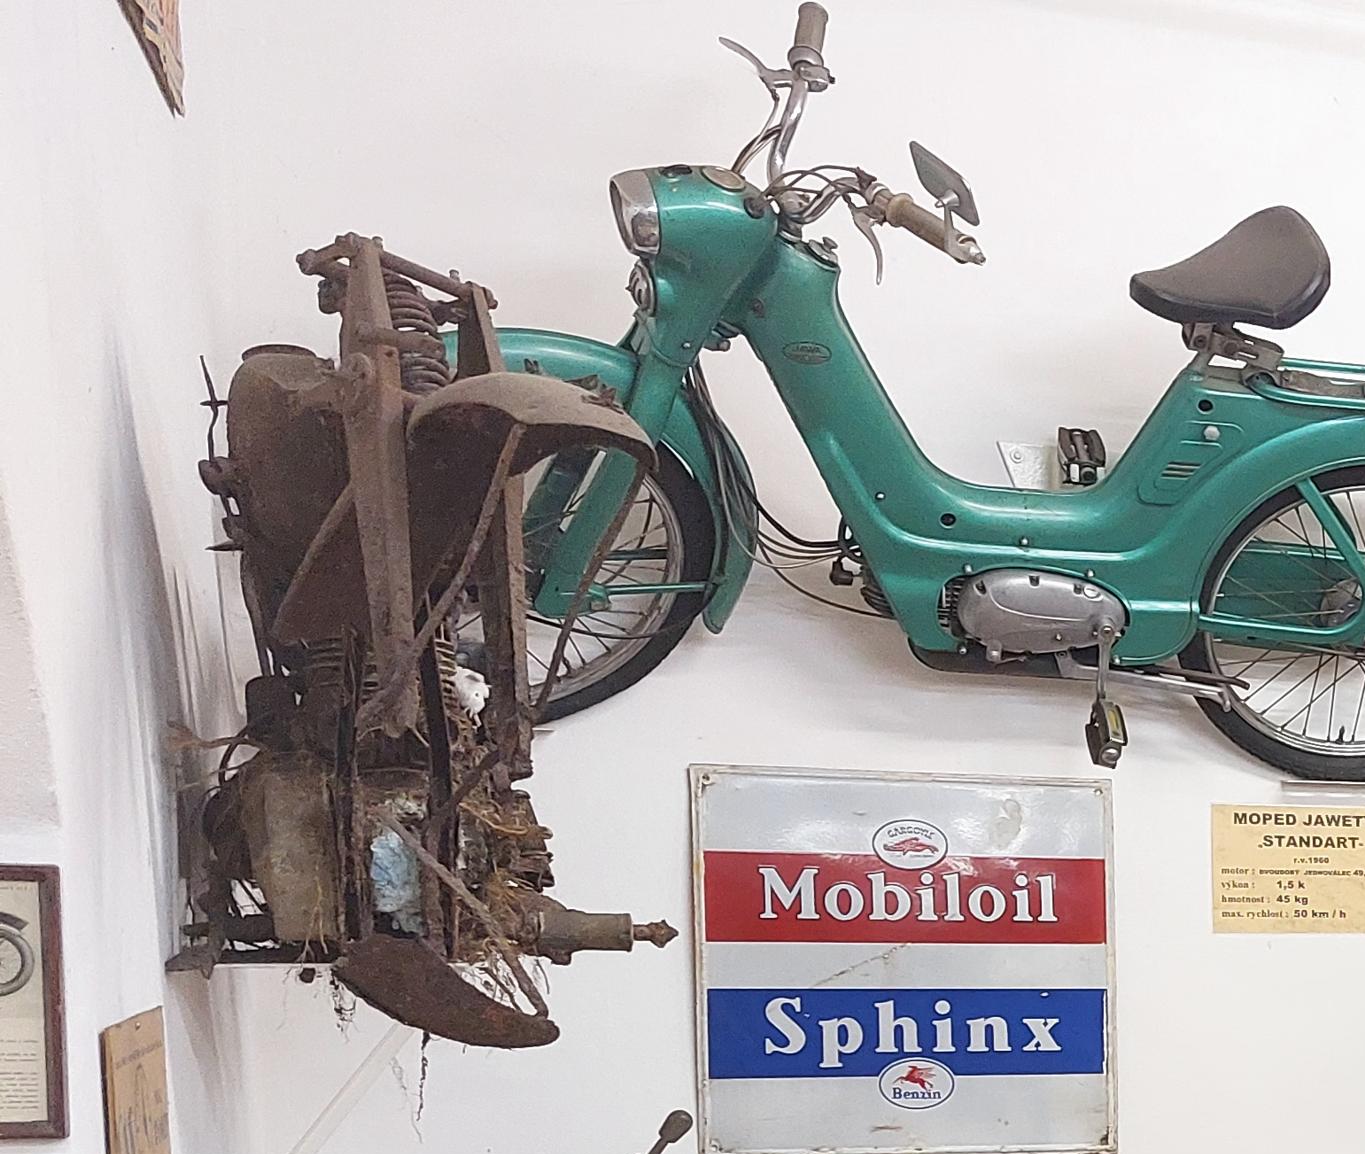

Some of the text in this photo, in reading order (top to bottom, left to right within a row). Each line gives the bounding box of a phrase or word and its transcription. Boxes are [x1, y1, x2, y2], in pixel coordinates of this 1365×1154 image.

[1234, 813, 1296, 825] MOPED
[1277, 881, 1294, 890] 1,5
[758, 865, 1059, 923] Mobiloil
[1276, 895, 1290, 903] 45
[1295, 895, 1308, 905] kg
[1293, 910, 1307, 918] 50
[1312, 910, 1329, 918] km
[1340, 910, 1346, 918] h
[764, 996, 1062, 1068] Sphinx
[892, 1088, 941, 1099] Benzin
